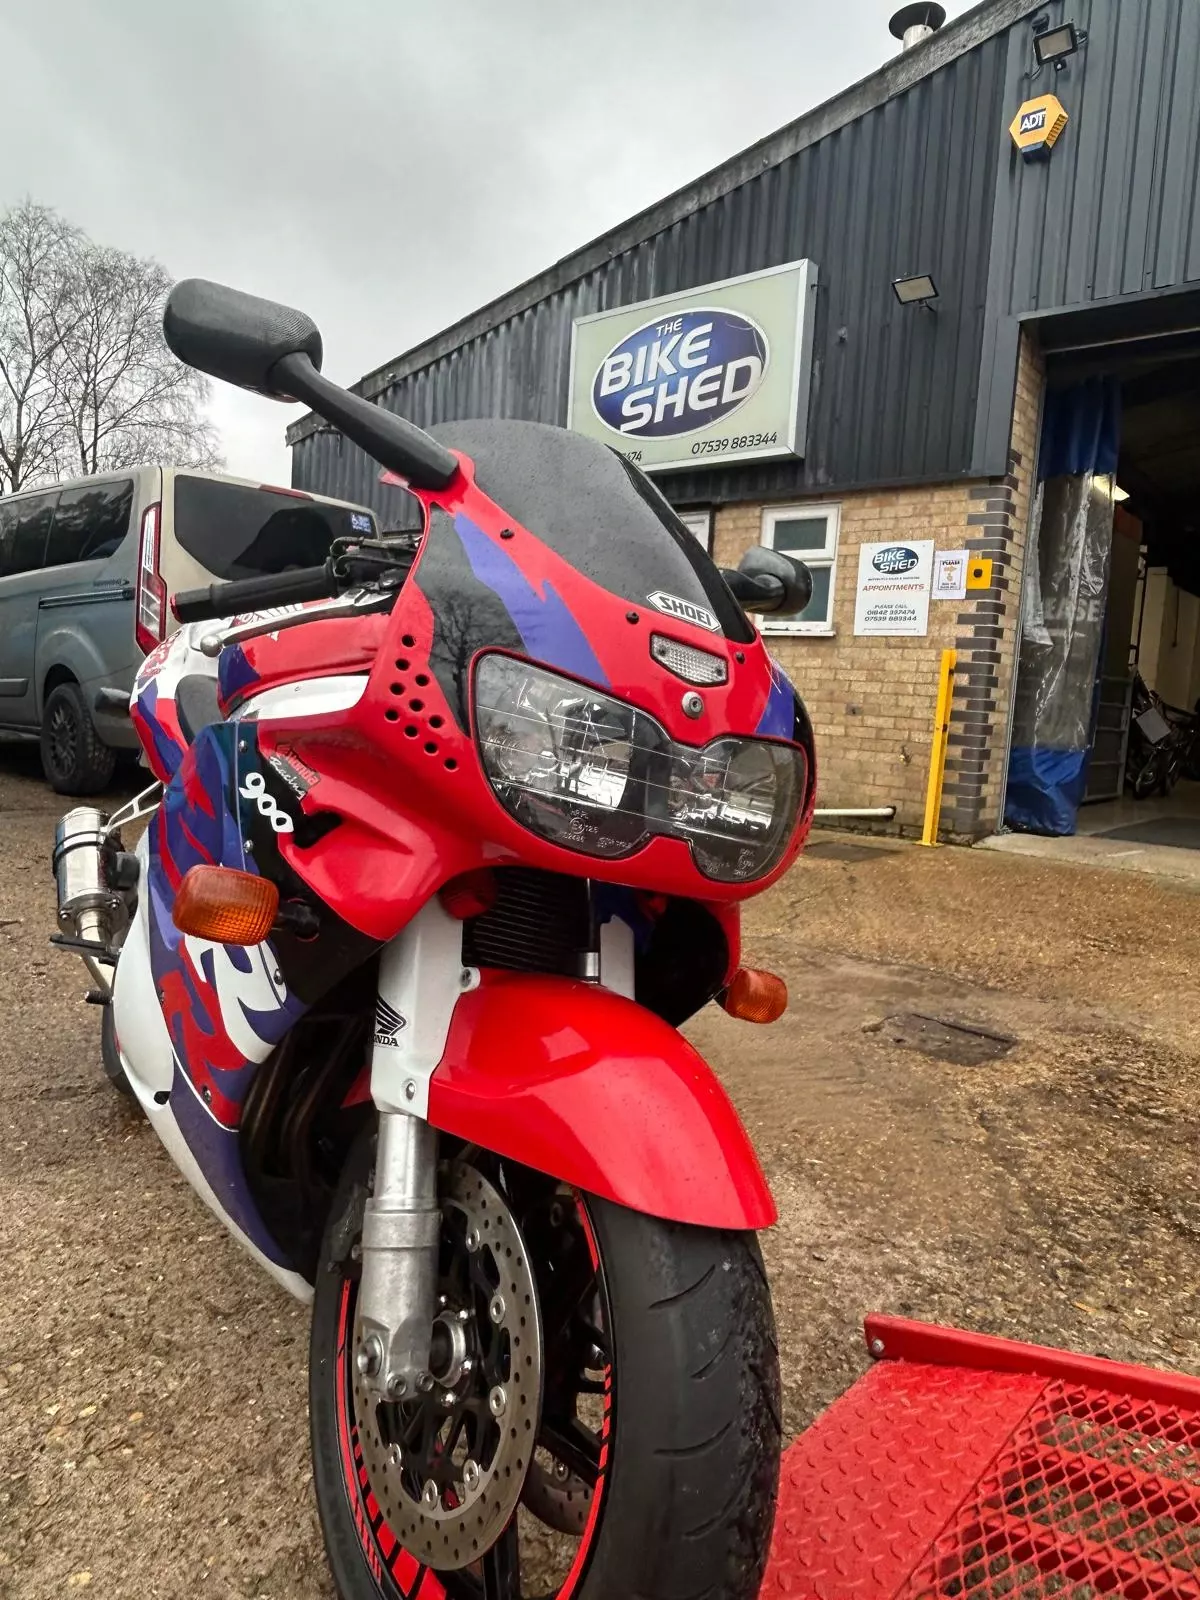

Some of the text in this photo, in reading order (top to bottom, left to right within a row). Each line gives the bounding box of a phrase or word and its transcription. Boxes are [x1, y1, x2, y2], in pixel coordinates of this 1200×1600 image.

[1020, 110, 1047, 131] ADT
[656, 318, 683, 338] THE
[600, 322, 713, 397] BIKE
[619, 355, 763, 433] SHED
[691, 431, 777, 455] 07539 883344
[874, 549, 906, 564] BIKE
[879, 558, 918, 573] SHED
[862, 583, 925, 591] APPOINTMENTS
[658, 595, 712, 627] SHOEI
[238, 772, 295, 832] 900
